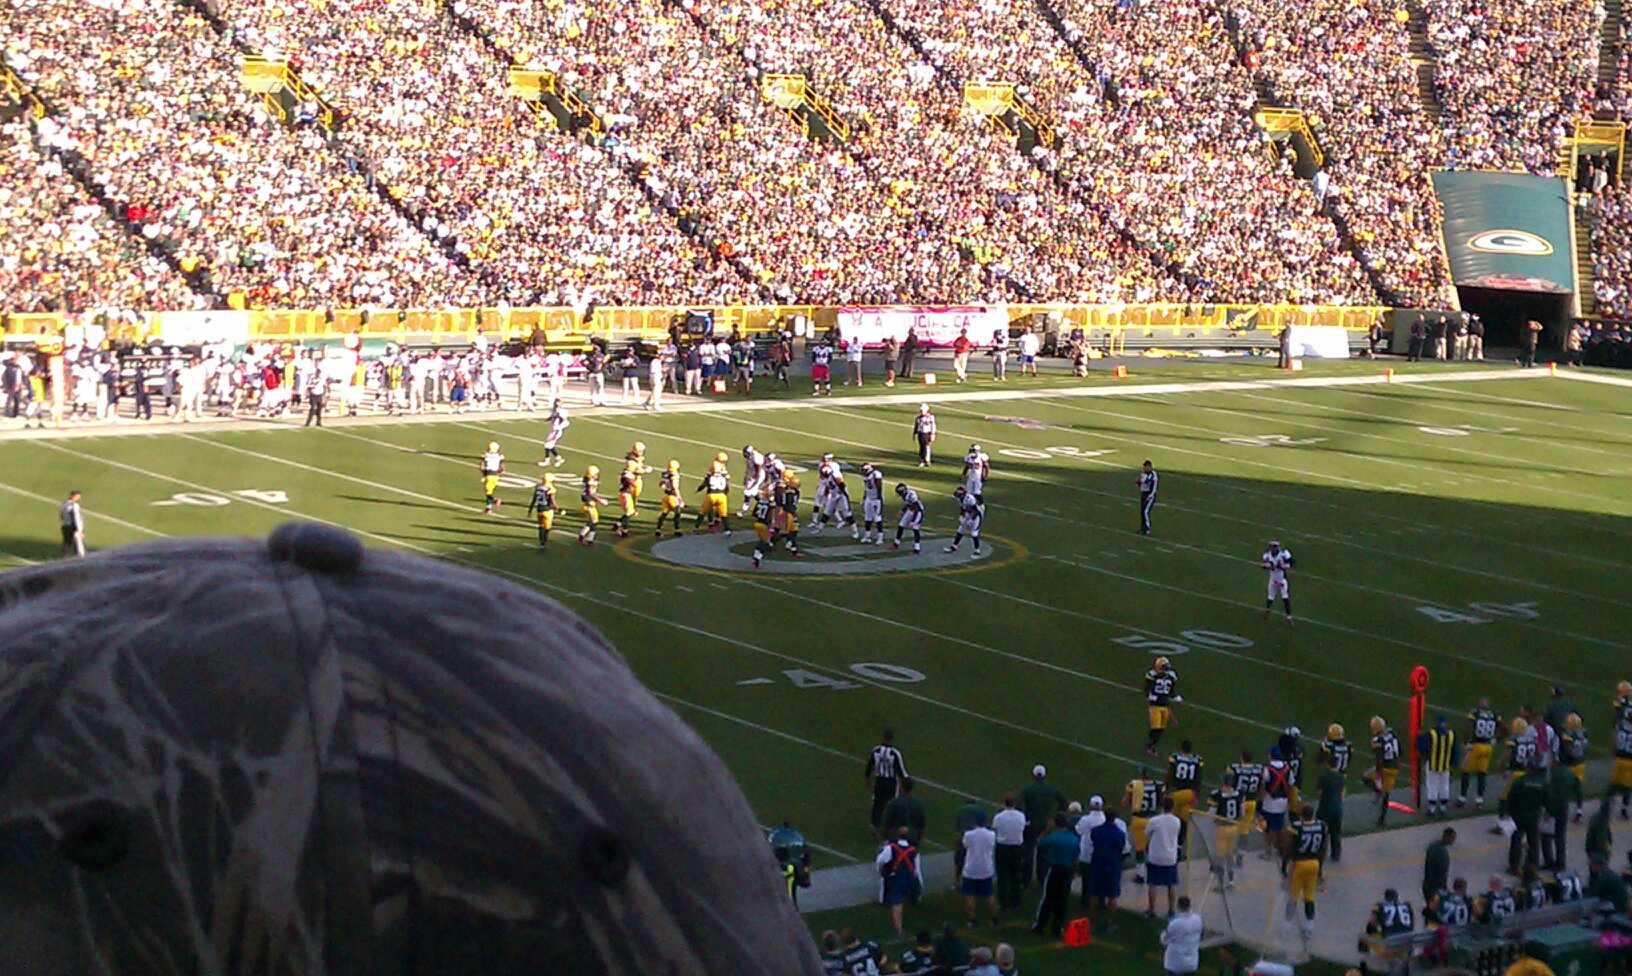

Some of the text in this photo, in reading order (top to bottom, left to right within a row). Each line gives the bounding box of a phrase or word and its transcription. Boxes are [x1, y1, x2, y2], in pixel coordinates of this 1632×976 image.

[1110, 629, 1254, 655] 50
[781, 662, 926, 690] 40
[1175, 762, 1197, 780] 81
[1383, 900, 1411, 926] 76
